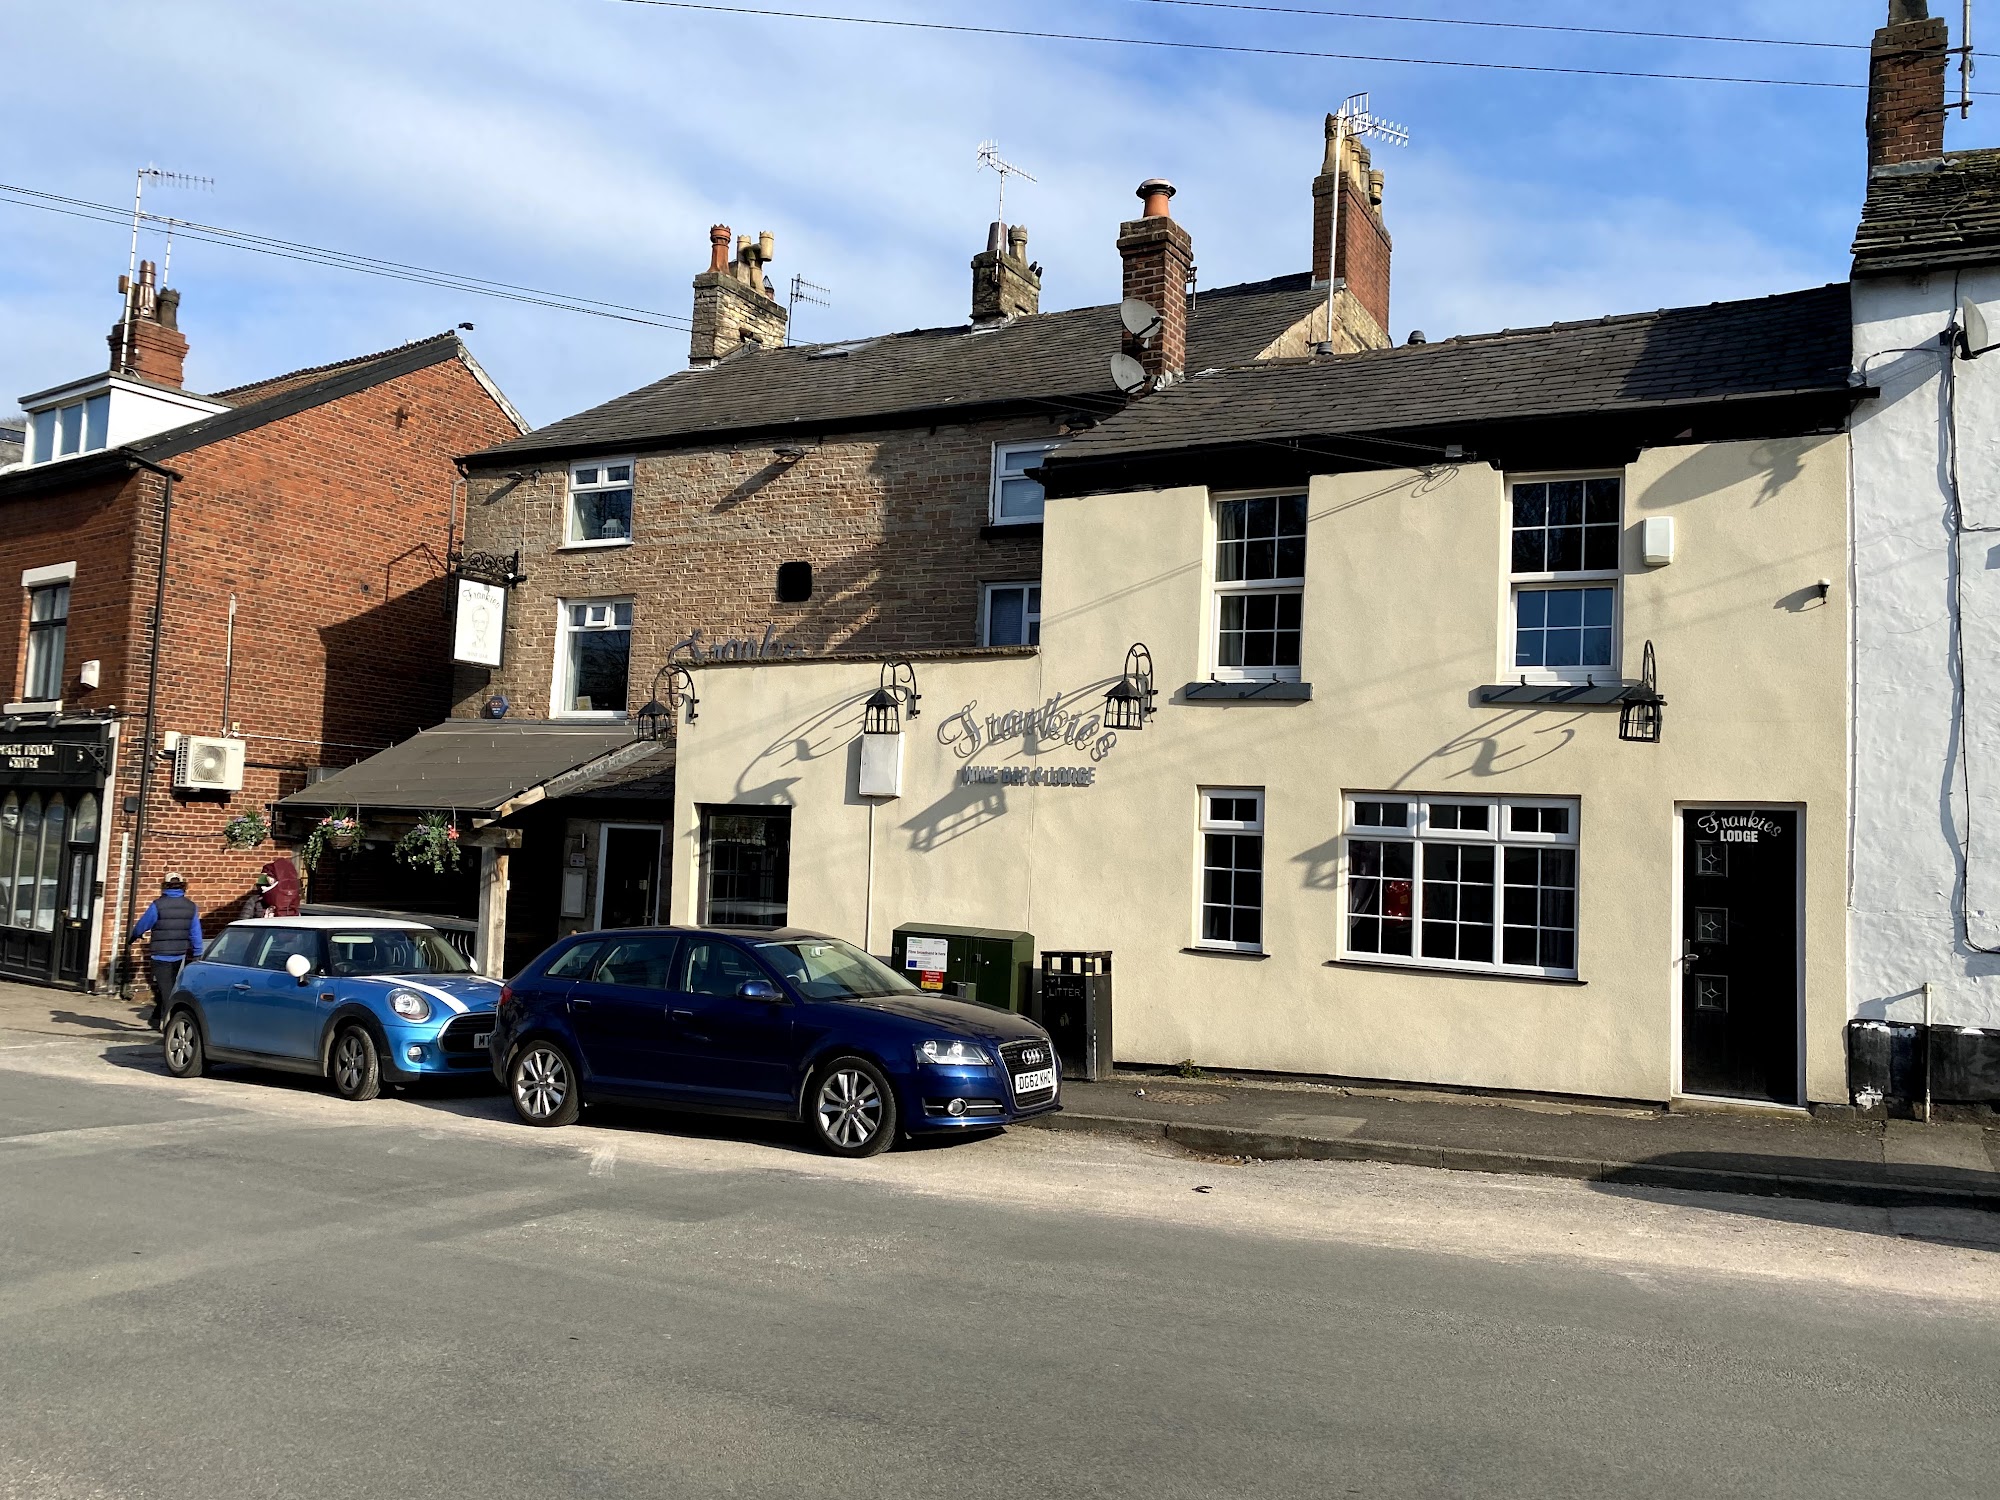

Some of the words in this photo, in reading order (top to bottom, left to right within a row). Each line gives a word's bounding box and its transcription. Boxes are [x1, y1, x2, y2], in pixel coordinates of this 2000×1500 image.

[938, 692, 1117, 760] Frankies
[963, 766, 998, 784] WINE
[1002, 766, 1030, 784] BAR
[1035, 766, 1044, 784] &
[1050, 767, 1096, 784] LODGE
[1697, 810, 1782, 837] Frankies
[1720, 830, 1758, 843] LODGE
[1049, 988, 1081, 997] LITTER
[1019, 1074, 1038, 1089] DG62
